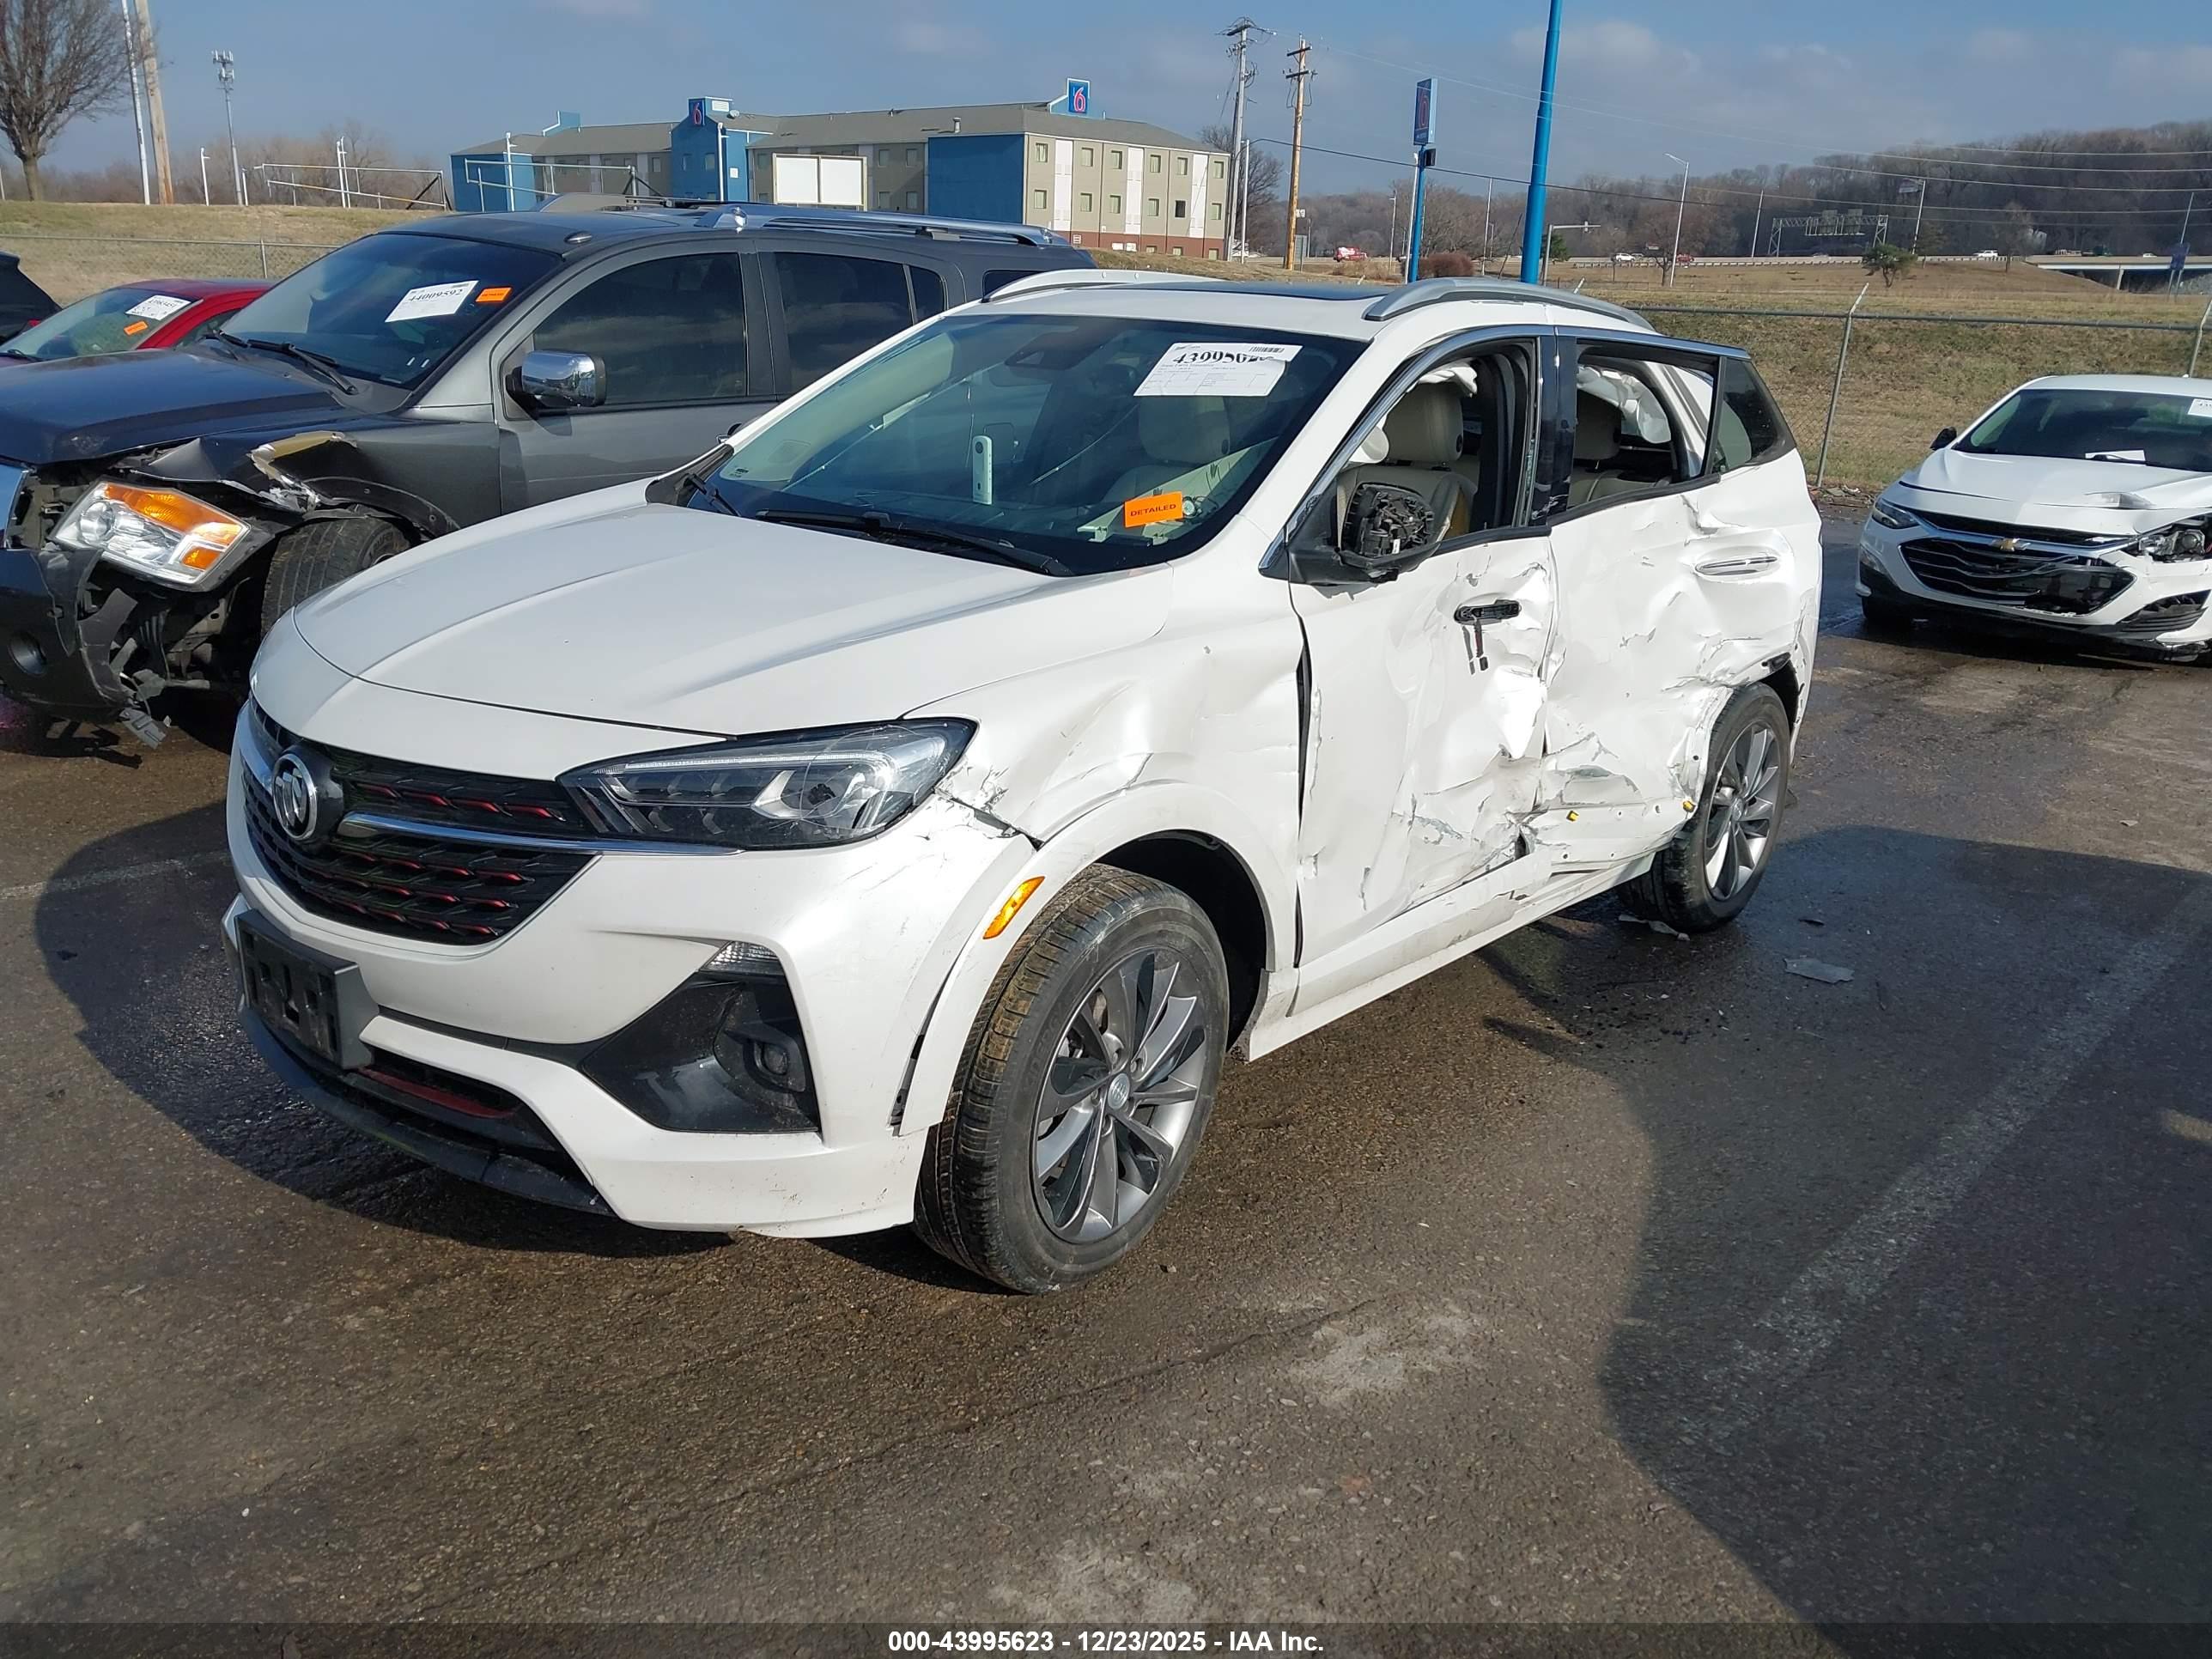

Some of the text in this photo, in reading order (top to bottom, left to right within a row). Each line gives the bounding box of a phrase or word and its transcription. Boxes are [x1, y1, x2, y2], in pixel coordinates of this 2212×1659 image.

[1073, 87, 1086, 112] 6
[693, 102, 702, 125] 6
[1173, 351, 1274, 365] 43995
[1130, 503, 1176, 516] DETAILED
